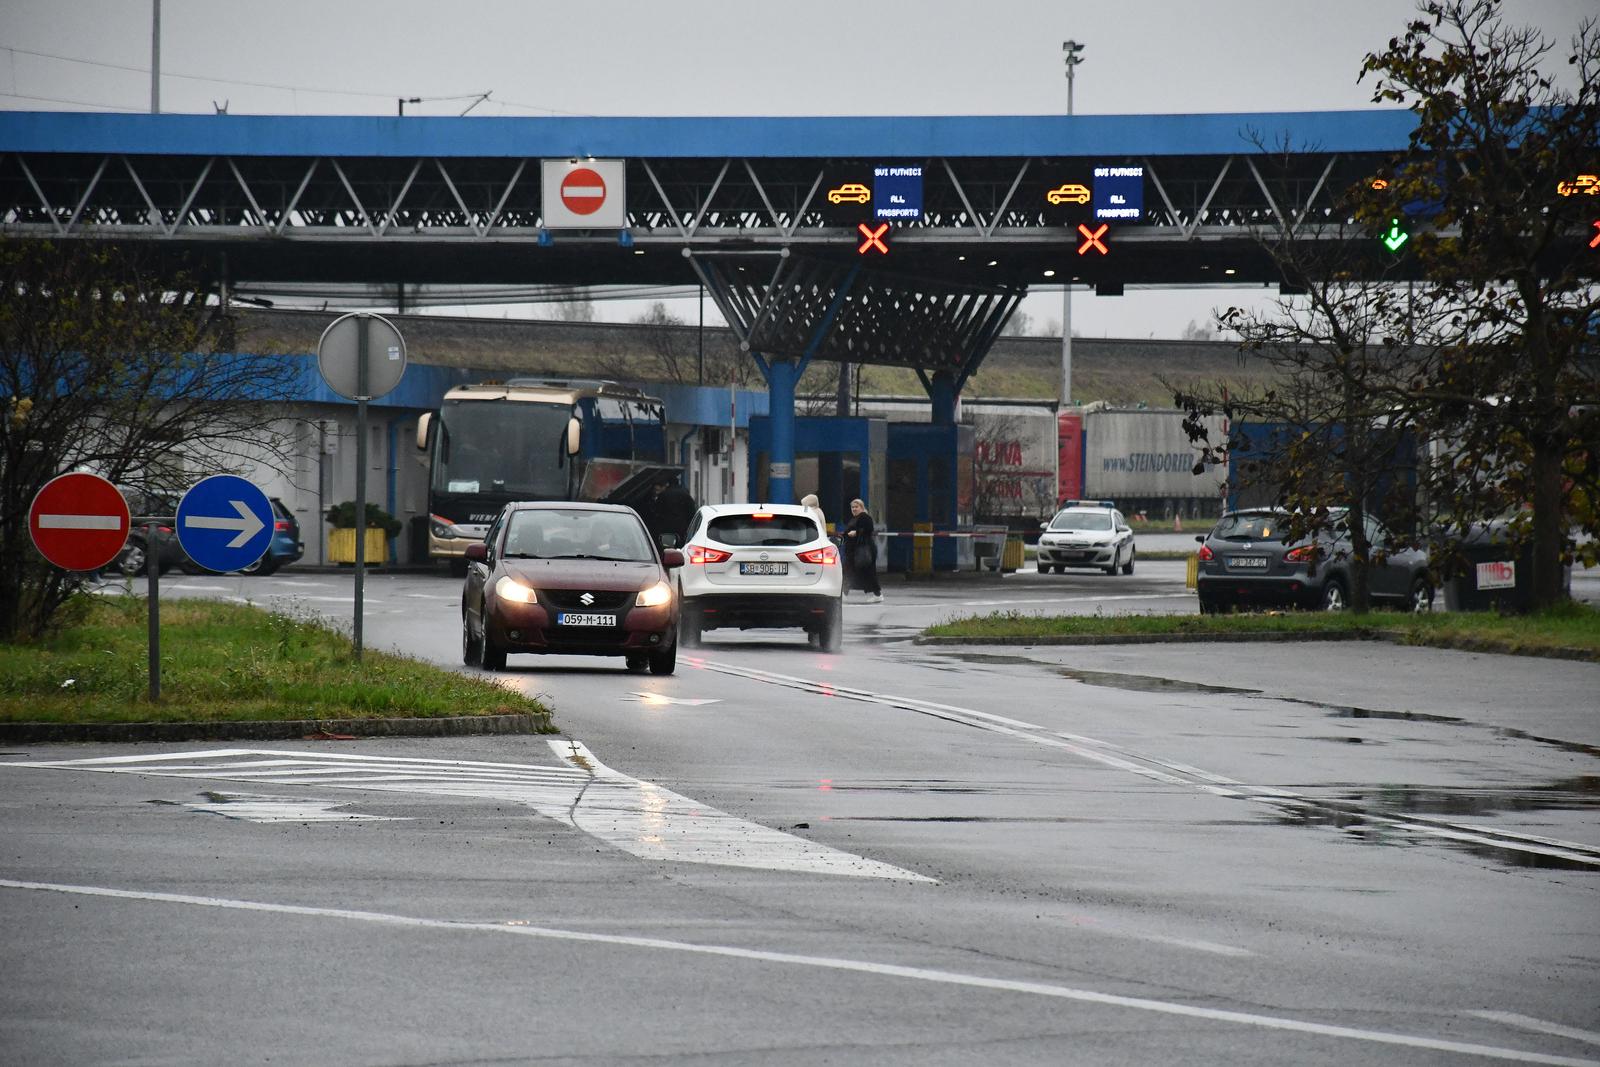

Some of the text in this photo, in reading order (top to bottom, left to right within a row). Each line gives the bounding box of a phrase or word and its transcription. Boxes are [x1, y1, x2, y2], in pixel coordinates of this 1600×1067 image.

[890, 168, 922, 177] PUTNICI
[1110, 168, 1143, 177] PUTNICI
[890, 195, 906, 204] ALL
[1110, 195, 1126, 204] ALL
[877, 208, 919, 217] PASSPORTS
[1097, 208, 1140, 218] PASSPORTS
[564, 614, 615, 626] 059-M-111
